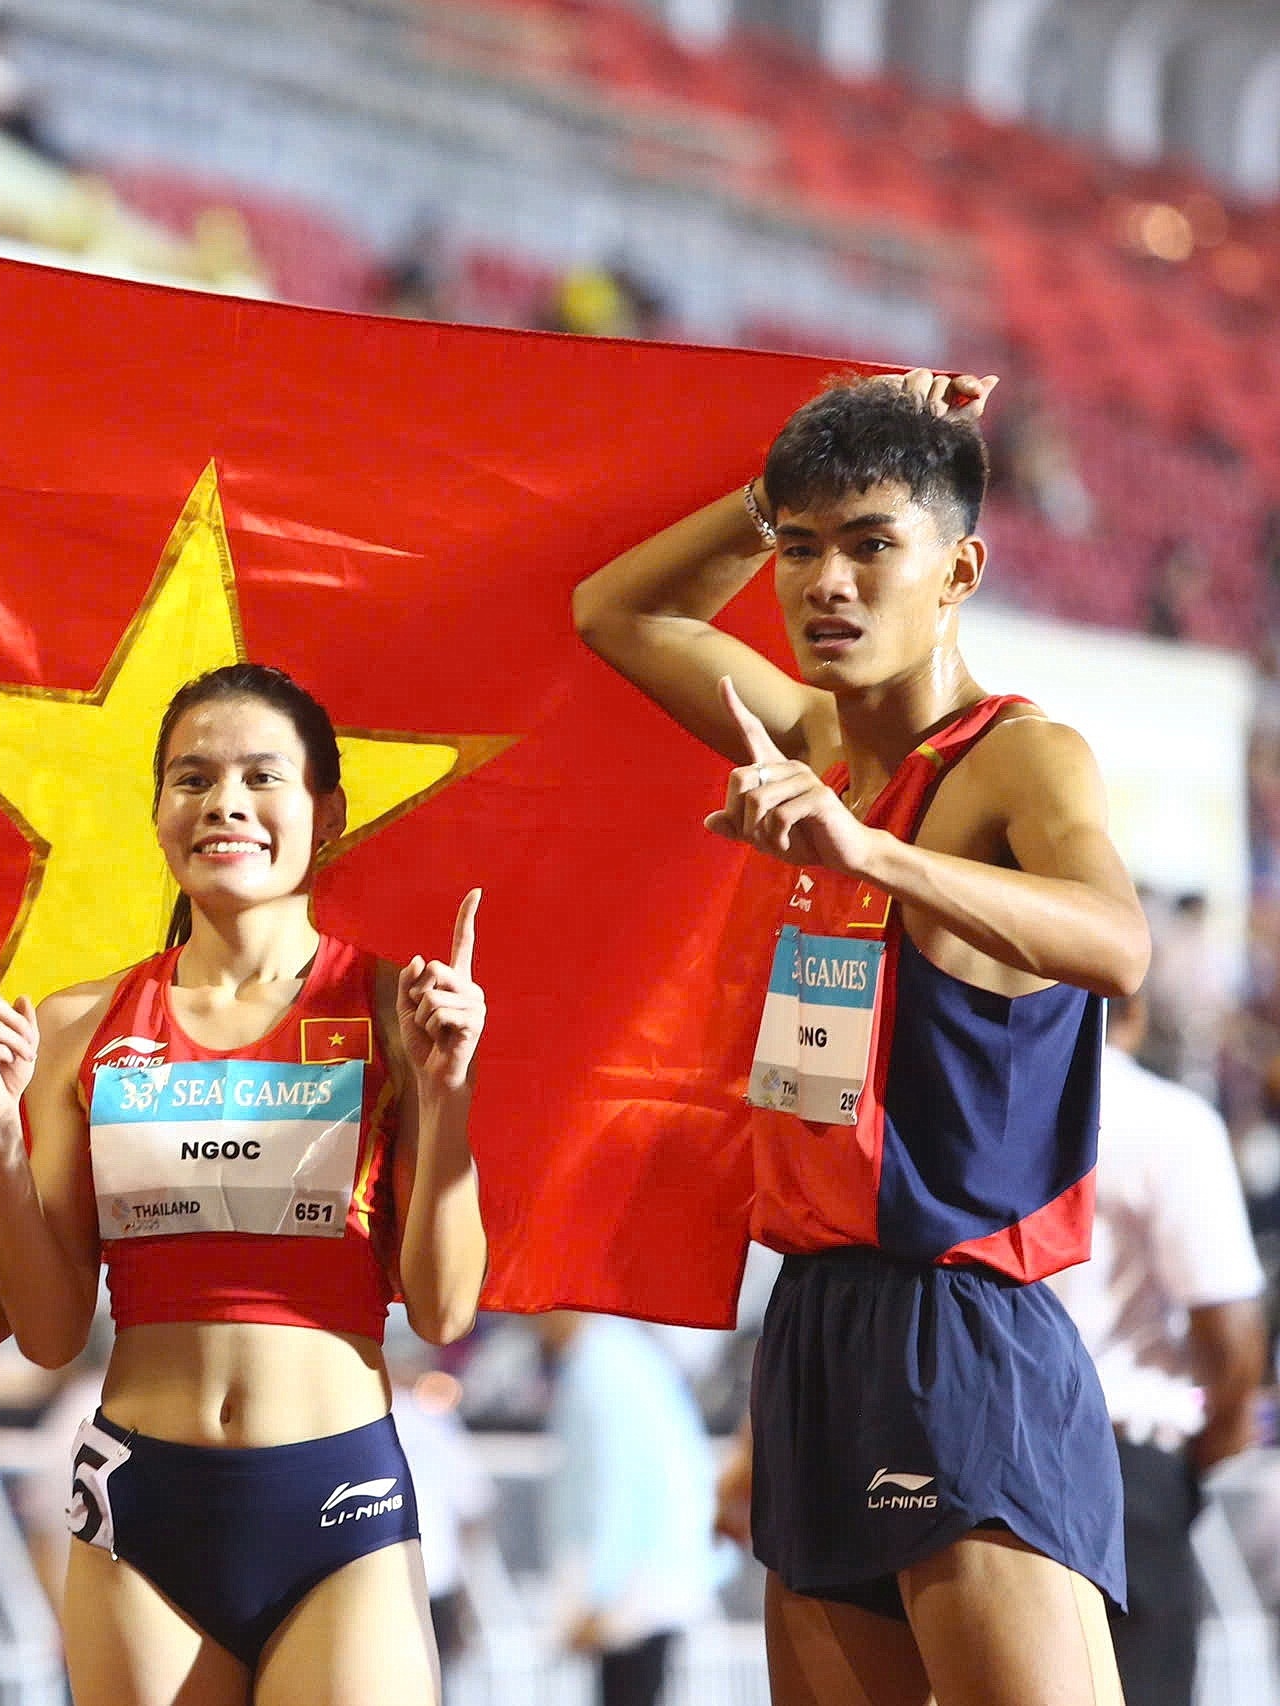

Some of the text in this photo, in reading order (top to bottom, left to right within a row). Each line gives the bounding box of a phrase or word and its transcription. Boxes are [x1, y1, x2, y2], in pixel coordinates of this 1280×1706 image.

[805, 957, 868, 991] GAMES
[172, 1079, 223, 1107] SEA
[234, 1079, 332, 1107] GAMES
[841, 1093, 858, 1111] 29
[181, 1141, 261, 1160] NGOC
[132, 1201, 333, 1222] THAILAND 651
[321, 1494, 403, 1527] LI-NING
[868, 1495, 938, 1509] LI-NING
